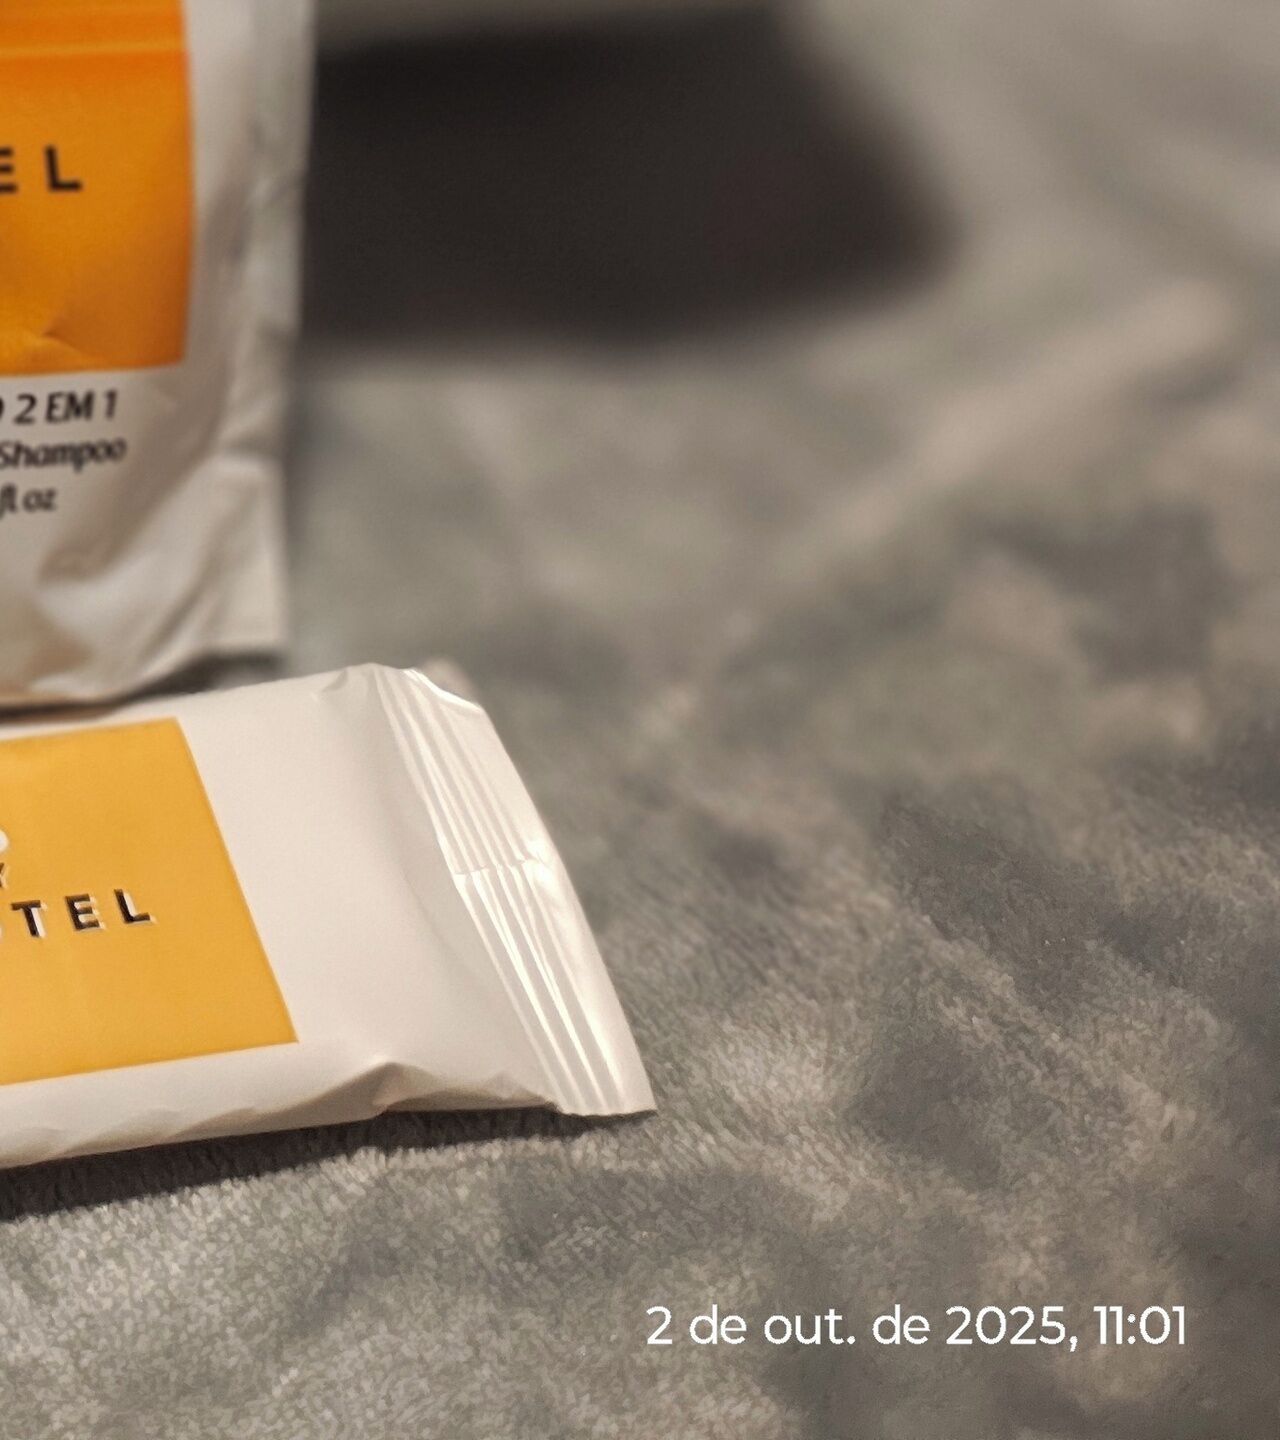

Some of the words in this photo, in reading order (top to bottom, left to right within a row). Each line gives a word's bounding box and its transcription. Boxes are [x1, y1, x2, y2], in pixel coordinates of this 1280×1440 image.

[13, 393, 37, 425] 2
[45, 390, 96, 423] EM
[103, 390, 118, 419] 1
